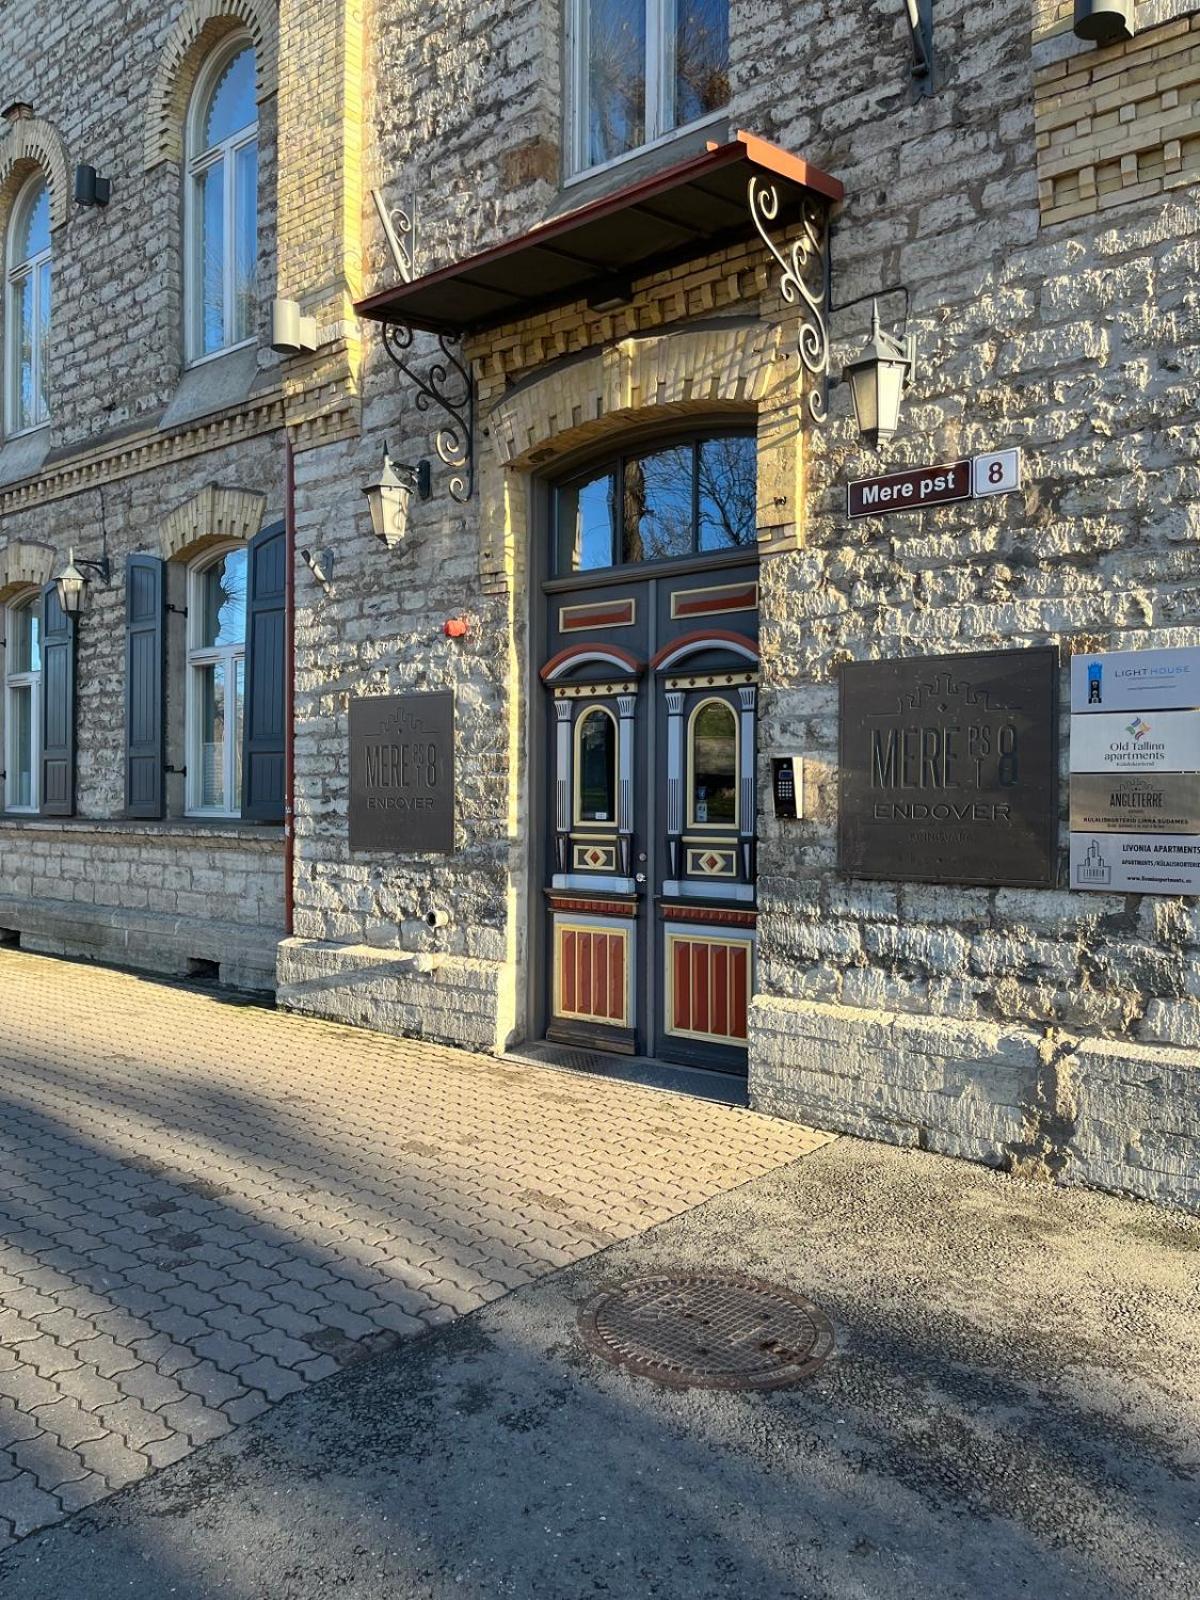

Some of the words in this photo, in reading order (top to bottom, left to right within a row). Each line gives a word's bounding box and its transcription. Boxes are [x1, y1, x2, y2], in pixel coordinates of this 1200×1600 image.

[988, 462, 1003, 484] 8
[862, 483, 913, 505] Mere
[920, 471, 955, 498] pst
[1110, 742, 1129, 751] Old
[1132, 742, 1165, 751] Tallinn
[870, 725, 960, 790] MERE
[997, 722, 1019, 789] 8
[1104, 752, 1165, 762] apartments
[365, 745, 409, 788] MERE
[427, 743, 437, 788] 8
[367, 797, 434, 809] ENDOVER
[1110, 793, 1163, 808] ANGLETERRE
[874, 803, 1011, 821] ENDOVER
[1122, 844, 1151, 852] LIVONIA
[1153, 845, 1200, 854] APARTMENTS
